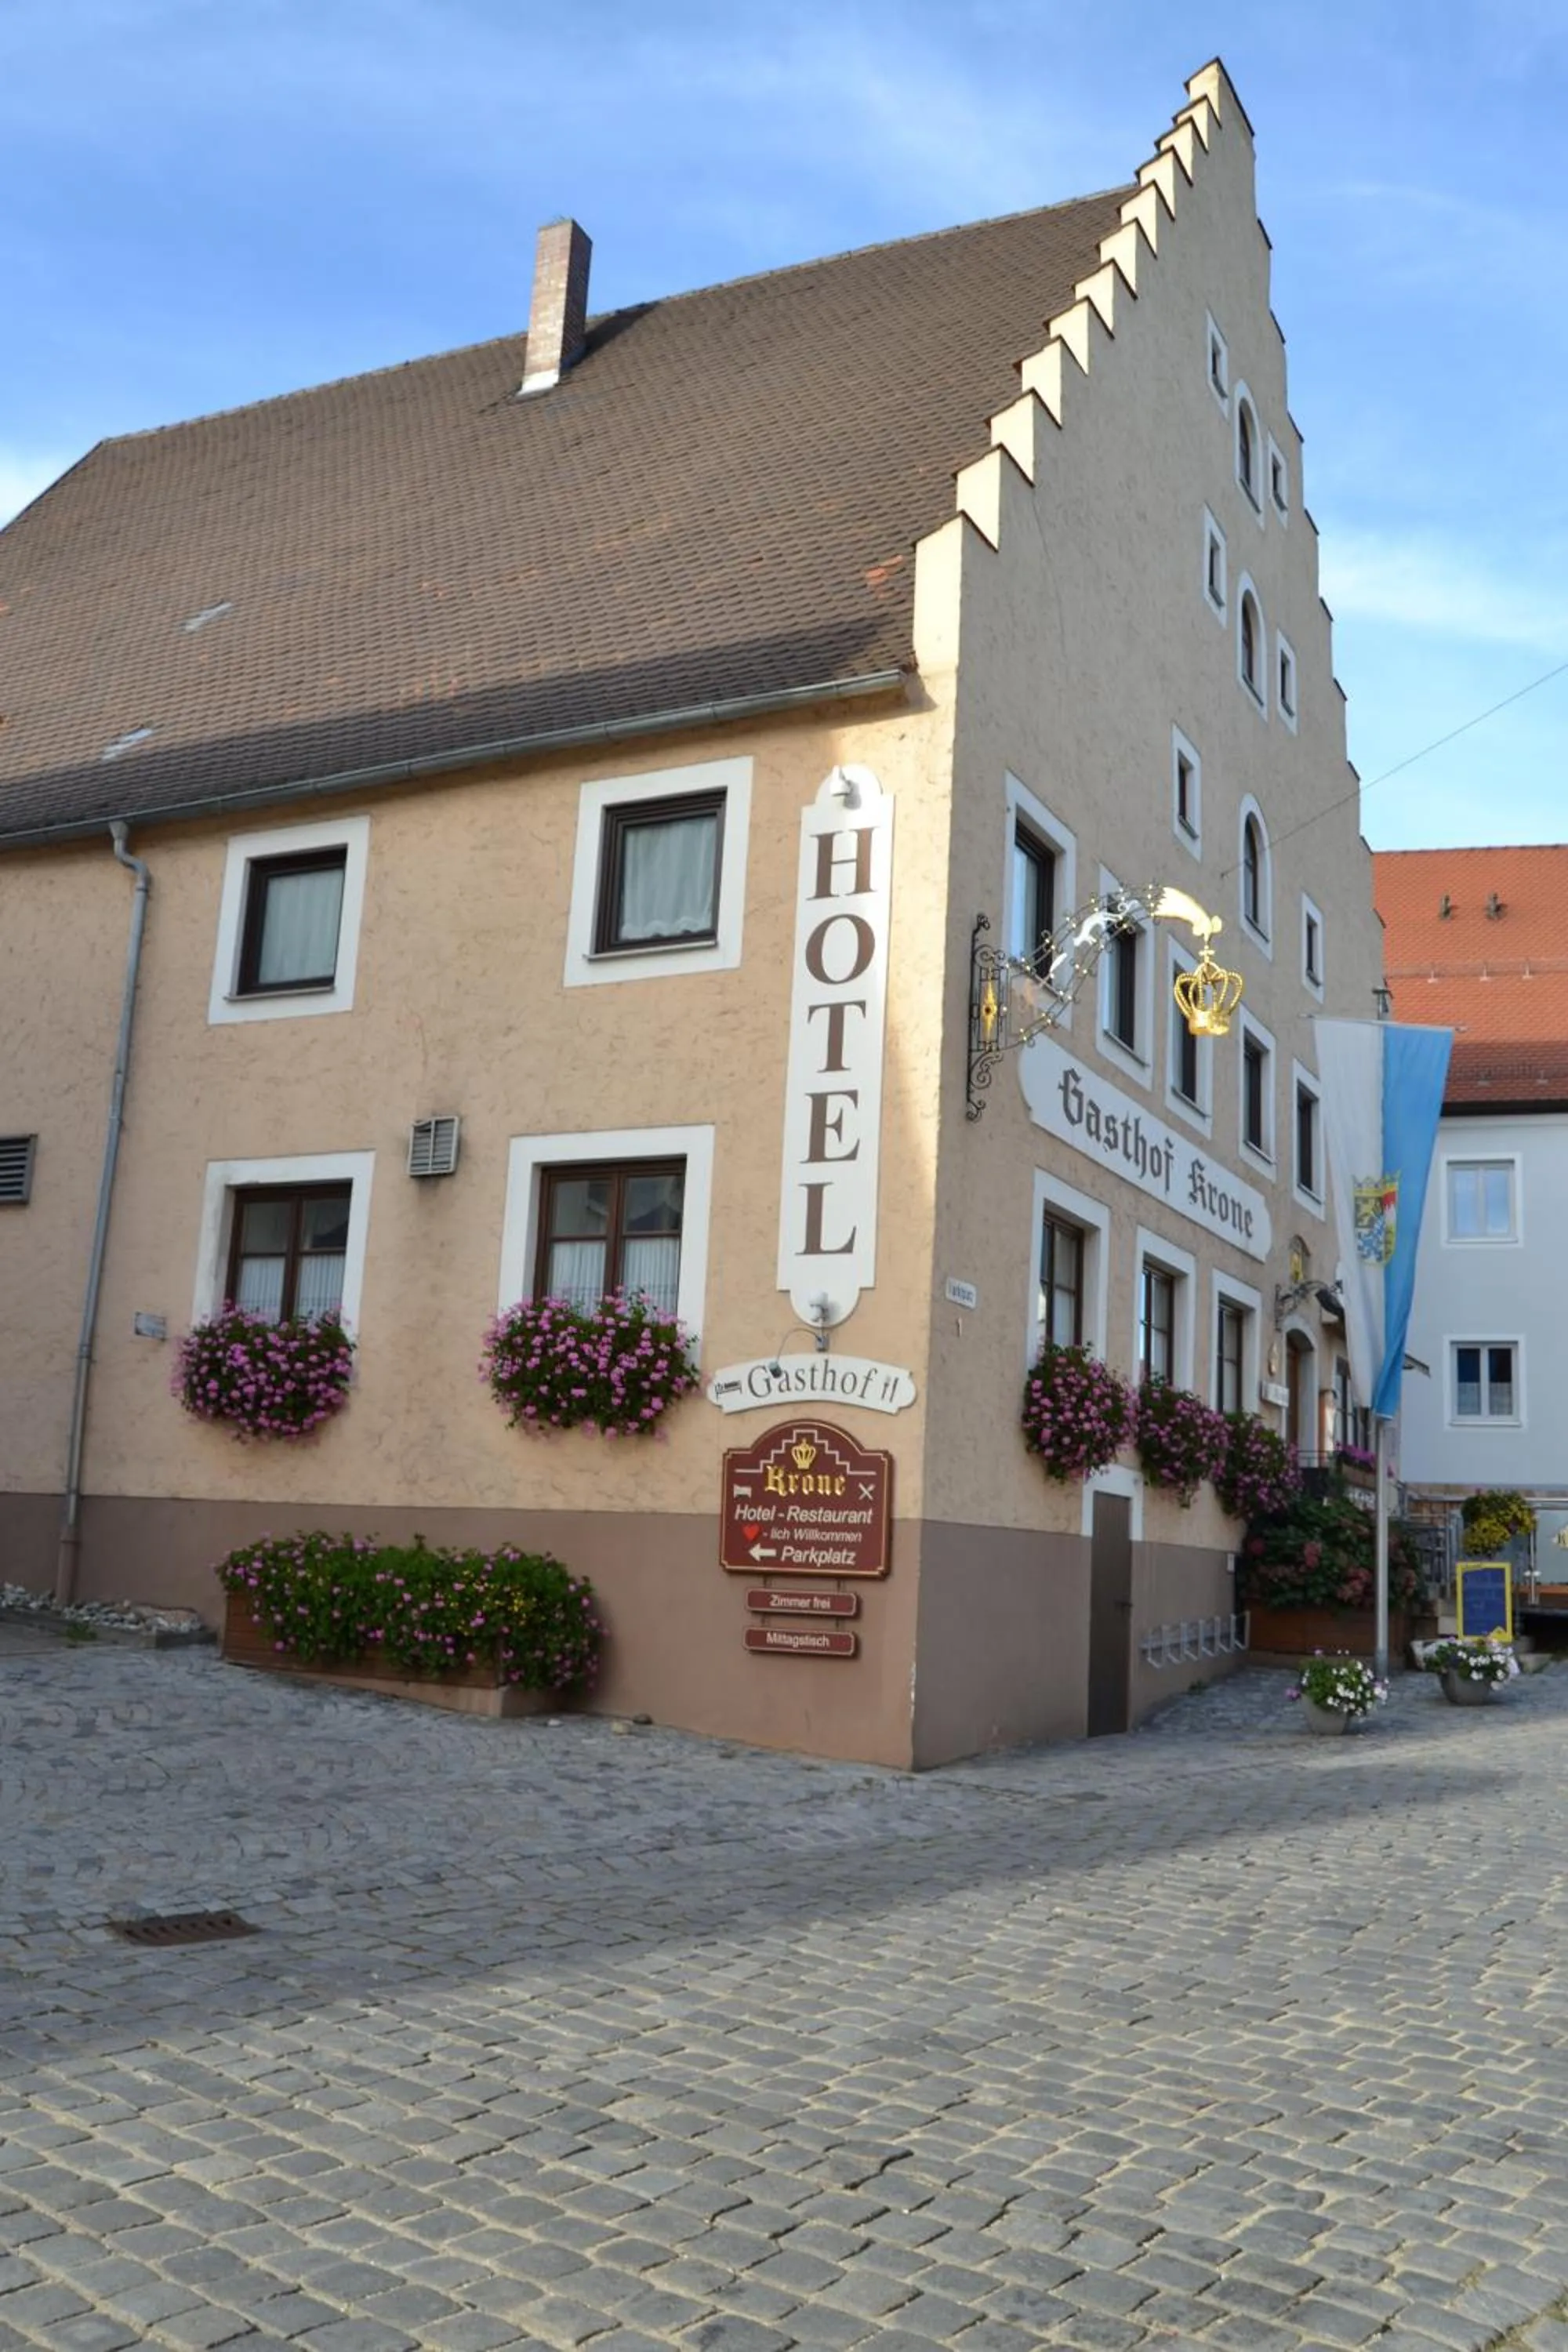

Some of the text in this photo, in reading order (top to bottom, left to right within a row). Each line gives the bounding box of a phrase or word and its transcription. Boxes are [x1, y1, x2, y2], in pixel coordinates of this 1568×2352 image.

[794, 826, 878, 1256] HOTEL
[1058, 1067, 1254, 1239] Gasthof Krone
[747, 1359, 878, 1399] Gasthof
[764, 1465, 846, 1497] Krone
[734, 1504, 777, 1522] Hotel
[786, 1505, 873, 1525] Restaurant
[770, 1527, 791, 1541] lich
[793, 1528, 863, 1543] Willkommen
[780, 1545, 857, 1567] Parkplatz
[769, 1594, 831, 1610] Zimmer frei
[765, 1632, 831, 1648] Mittagstisch
